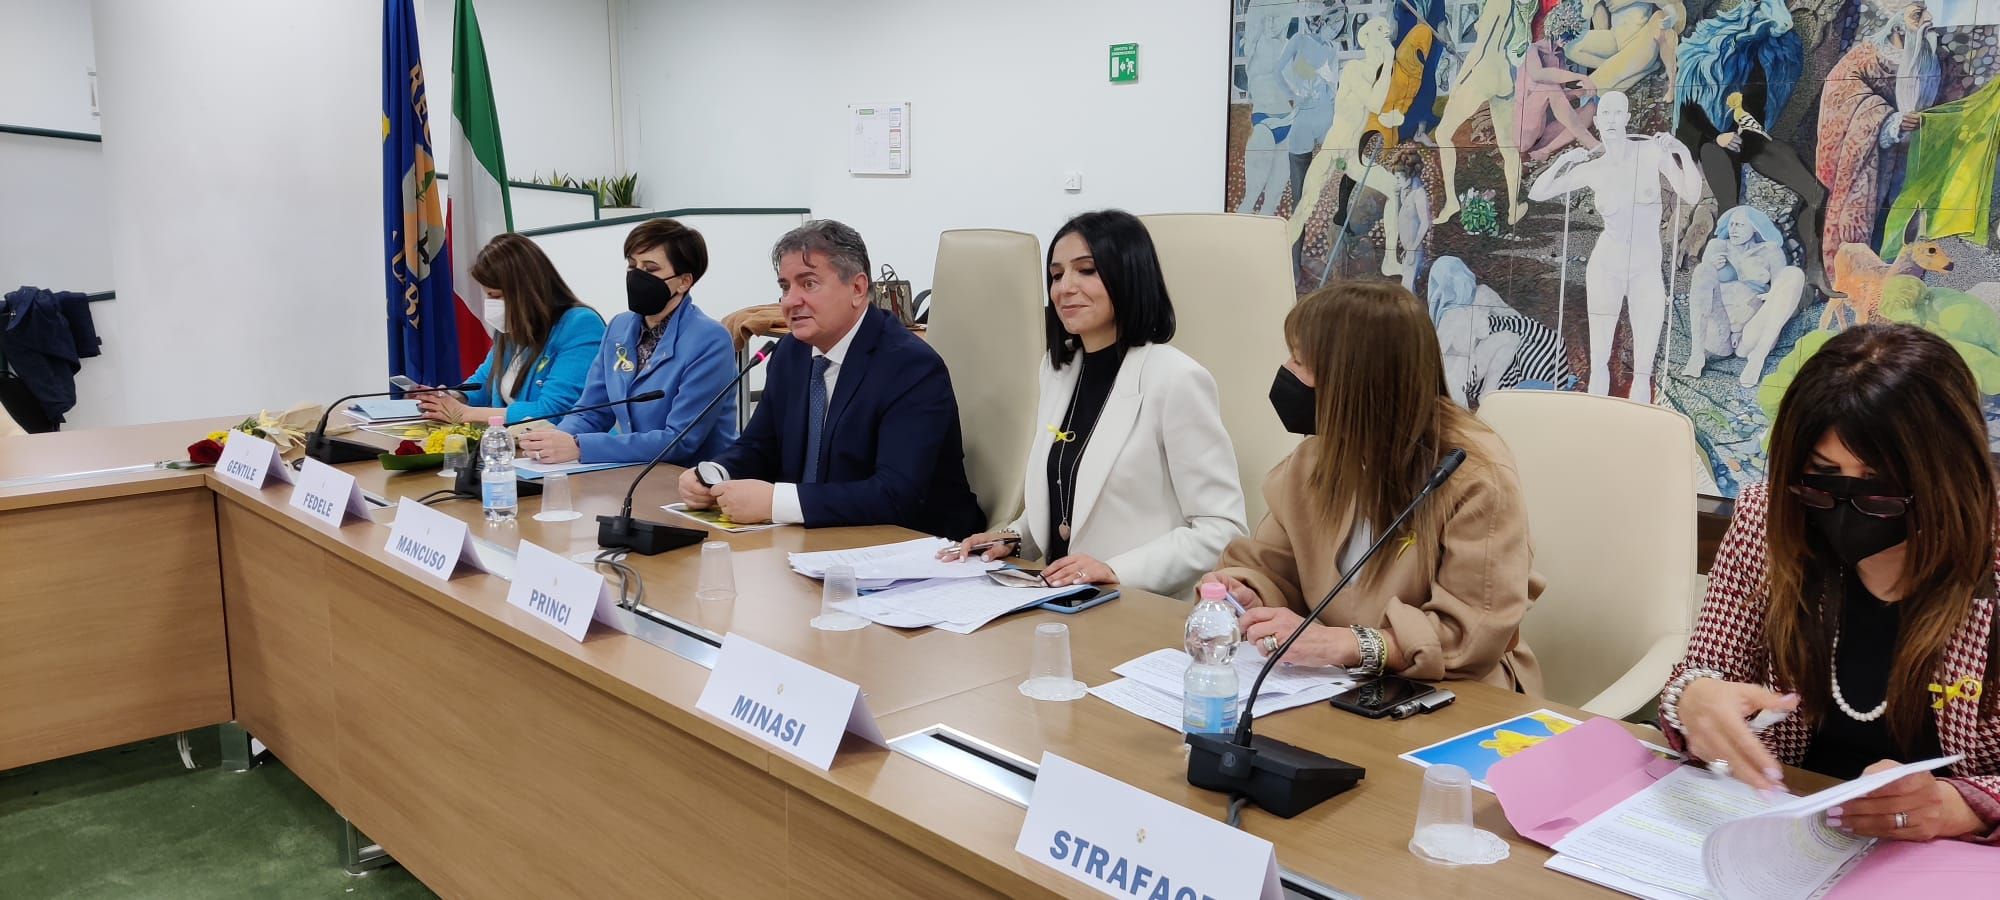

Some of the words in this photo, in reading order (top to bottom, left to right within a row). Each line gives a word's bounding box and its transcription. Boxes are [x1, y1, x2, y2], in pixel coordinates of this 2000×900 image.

[226, 459, 257, 481] GENTILE
[303, 492, 333, 517] FEDELE
[396, 535, 446, 570] MANCUSO
[529, 589, 572, 626] PRINCI
[730, 694, 806, 746] MINASI
[1049, 830, 1216, 900] STRAFA
